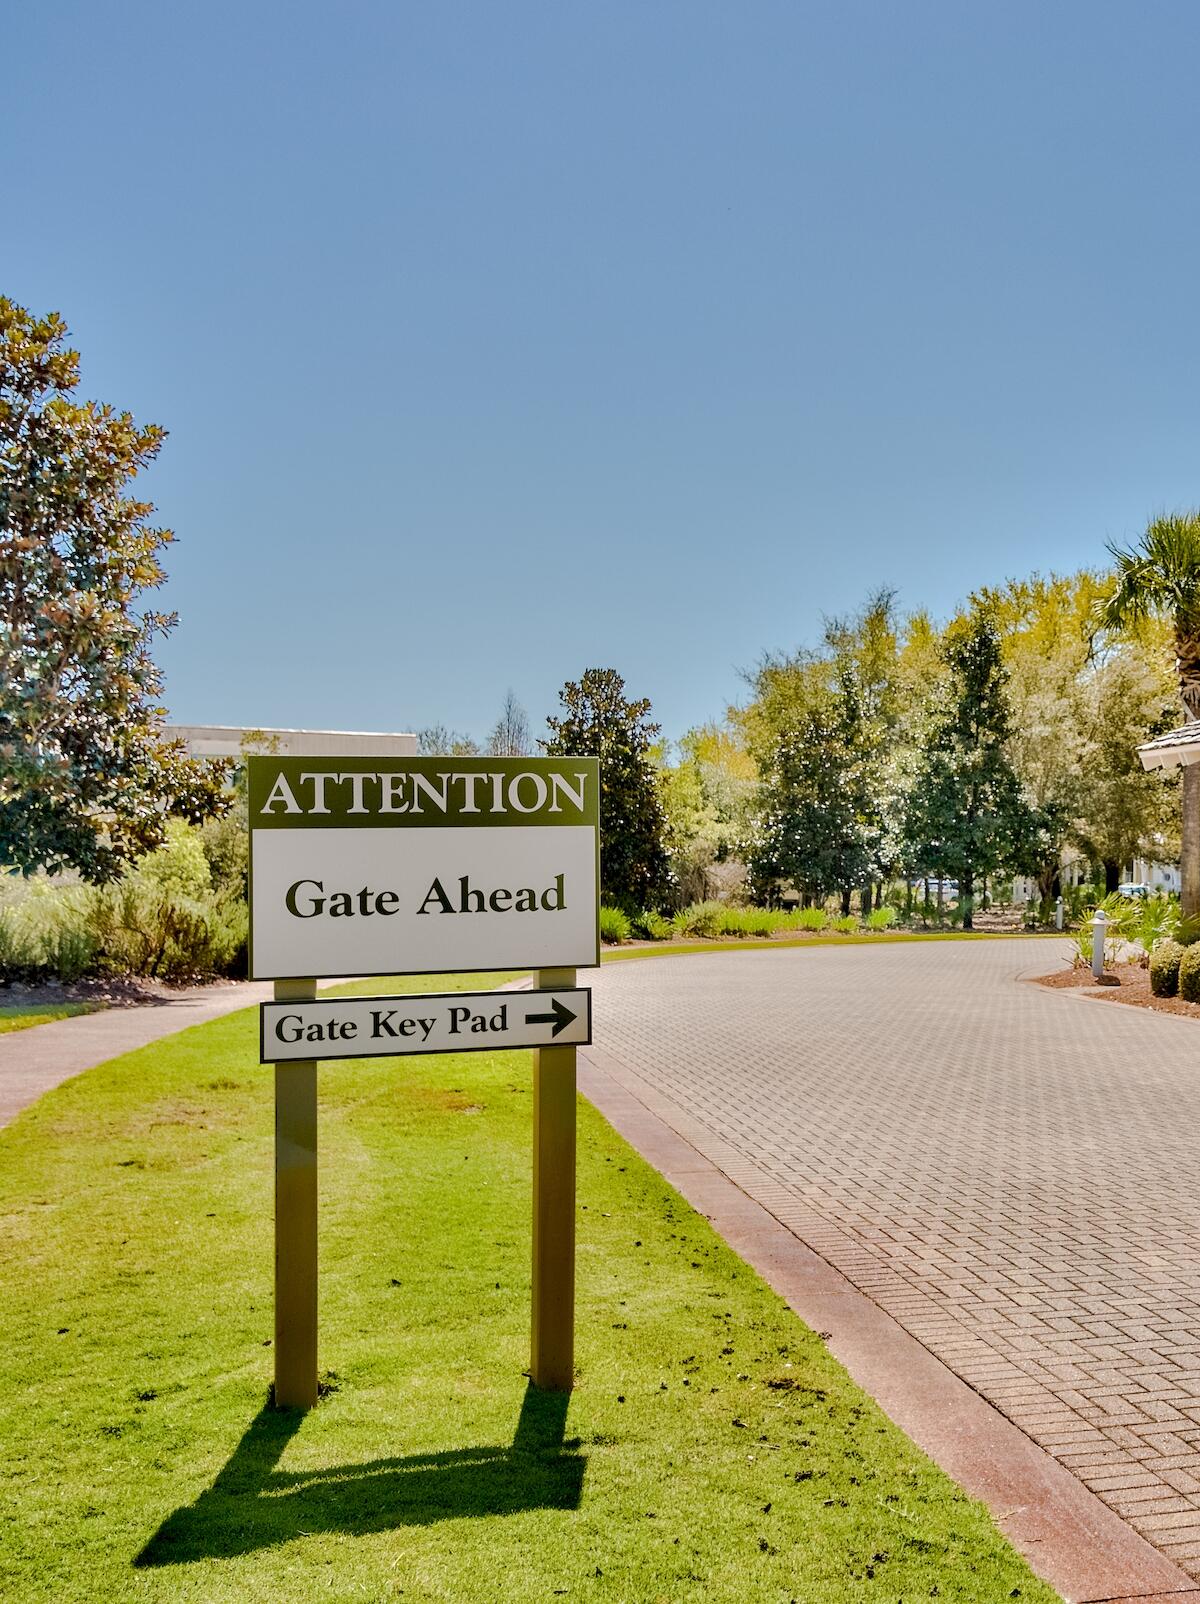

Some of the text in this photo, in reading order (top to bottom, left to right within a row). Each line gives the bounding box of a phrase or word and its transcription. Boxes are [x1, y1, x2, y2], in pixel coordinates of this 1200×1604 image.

[259, 771, 588, 815] ATTENTION
[285, 873, 568, 919] Gate Ahead
[274, 1004, 509, 1044] Gate Key Pad
